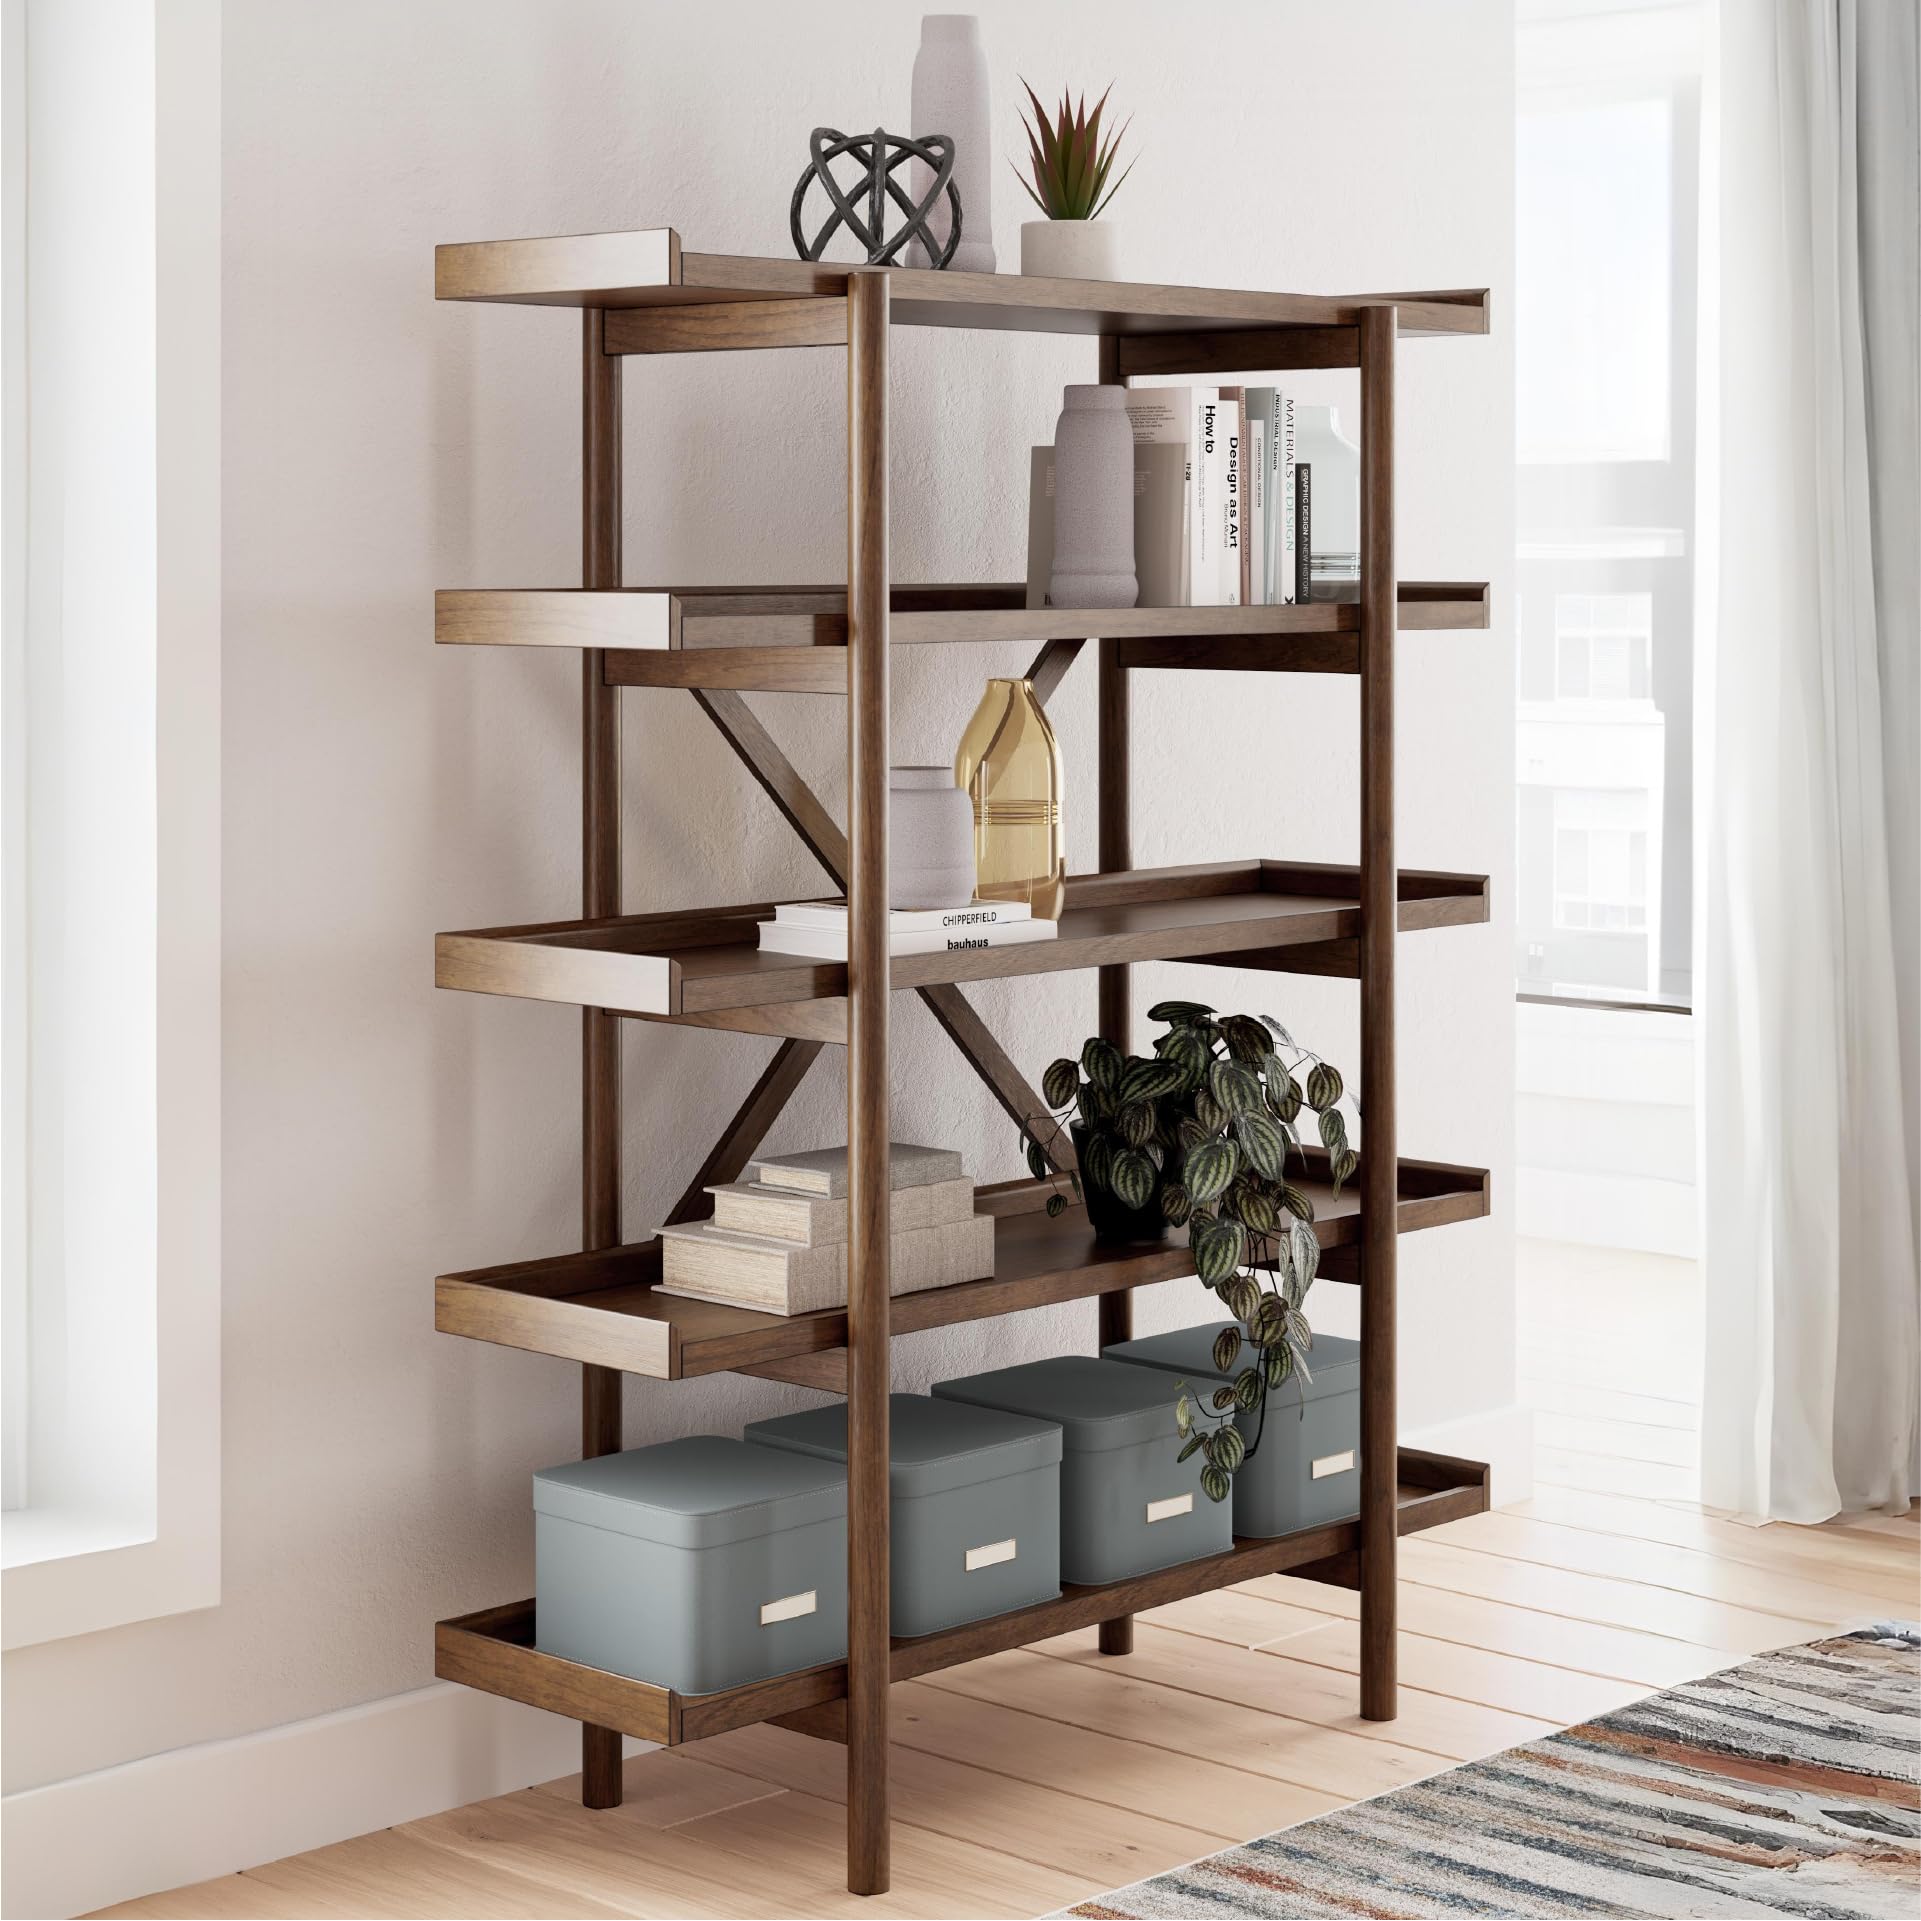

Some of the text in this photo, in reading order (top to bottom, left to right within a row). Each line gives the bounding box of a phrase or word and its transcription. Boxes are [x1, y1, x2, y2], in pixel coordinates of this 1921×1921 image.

[1205, 405, 1216, 454] How to
[1227, 437, 1239, 549] Design as Art
[1286, 399, 1294, 551] MATERIALS & DESIGN
[942, 911, 997, 927] CHIPPERFIELD
[947, 937, 989, 951] bauhaus
